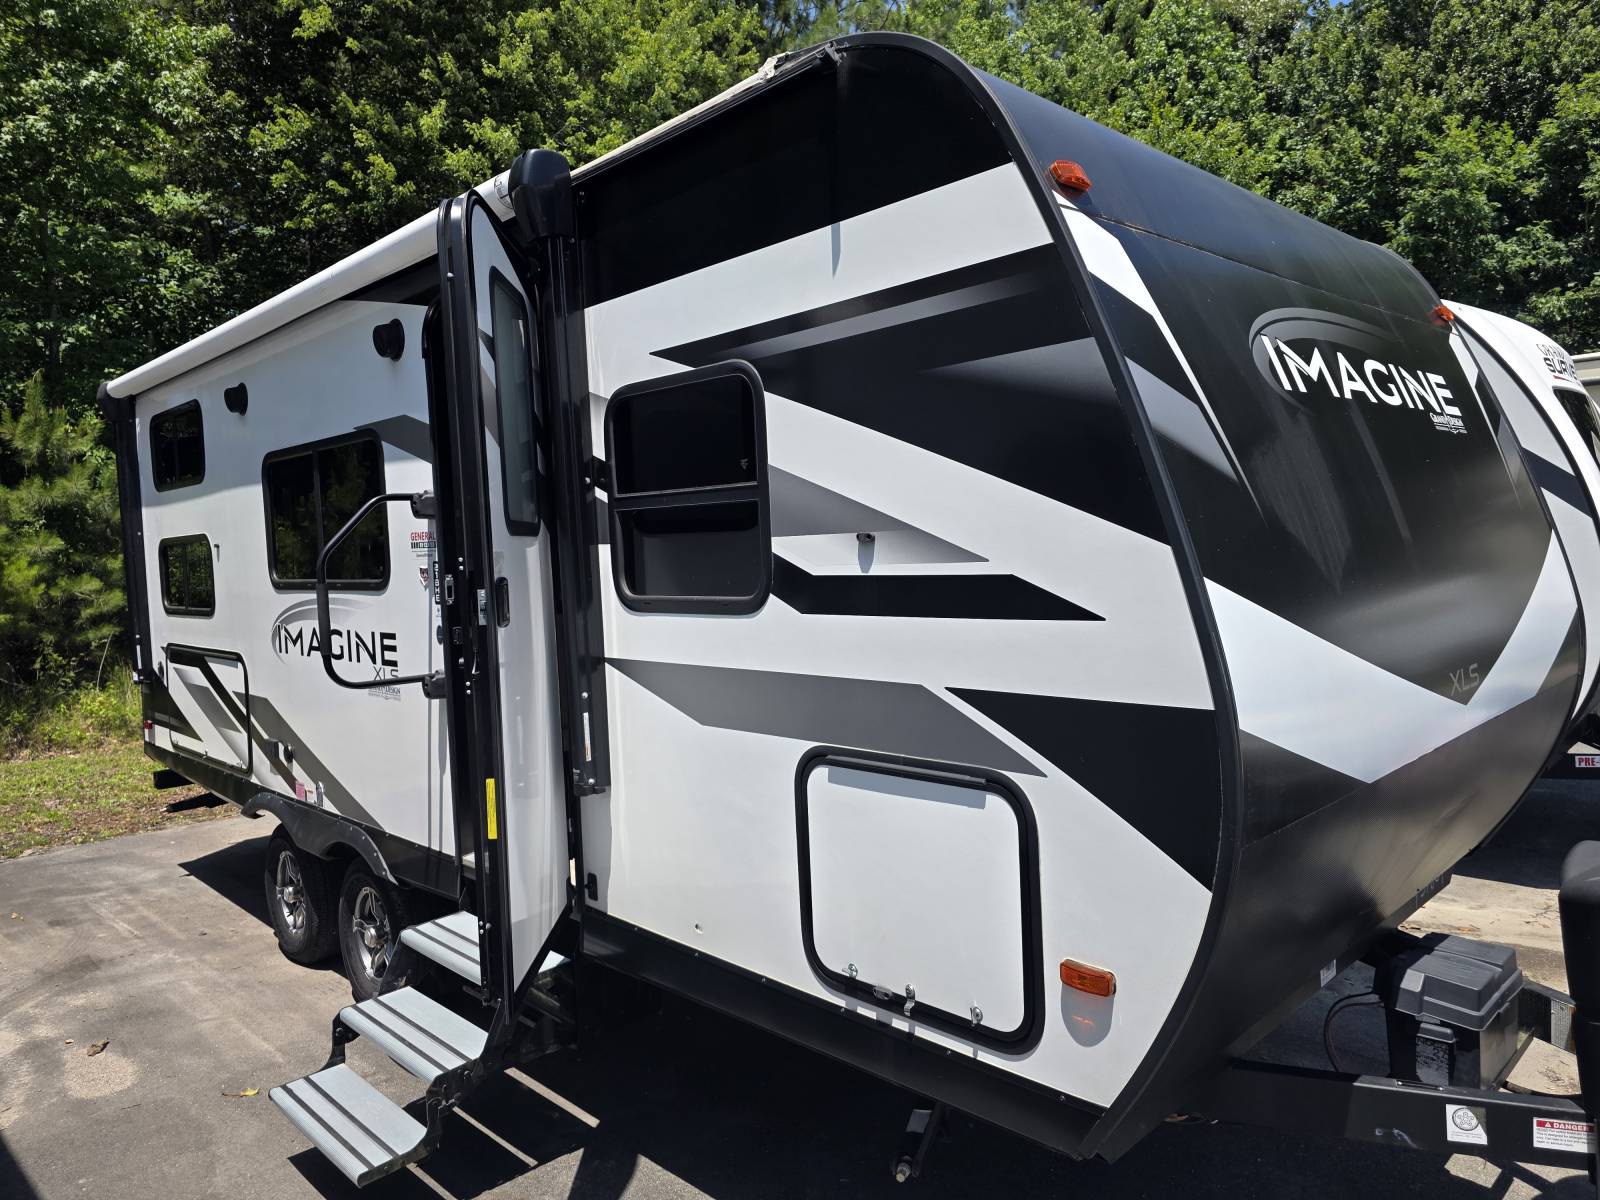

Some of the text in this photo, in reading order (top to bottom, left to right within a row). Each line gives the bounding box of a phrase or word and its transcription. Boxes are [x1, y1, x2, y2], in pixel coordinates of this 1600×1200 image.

[1260, 333, 1463, 417] IMAGINE
[277, 622, 399, 668] IMAGINE
[1448, 662, 1481, 697] XLS
[1553, 1122, 1590, 1132] DANGER
